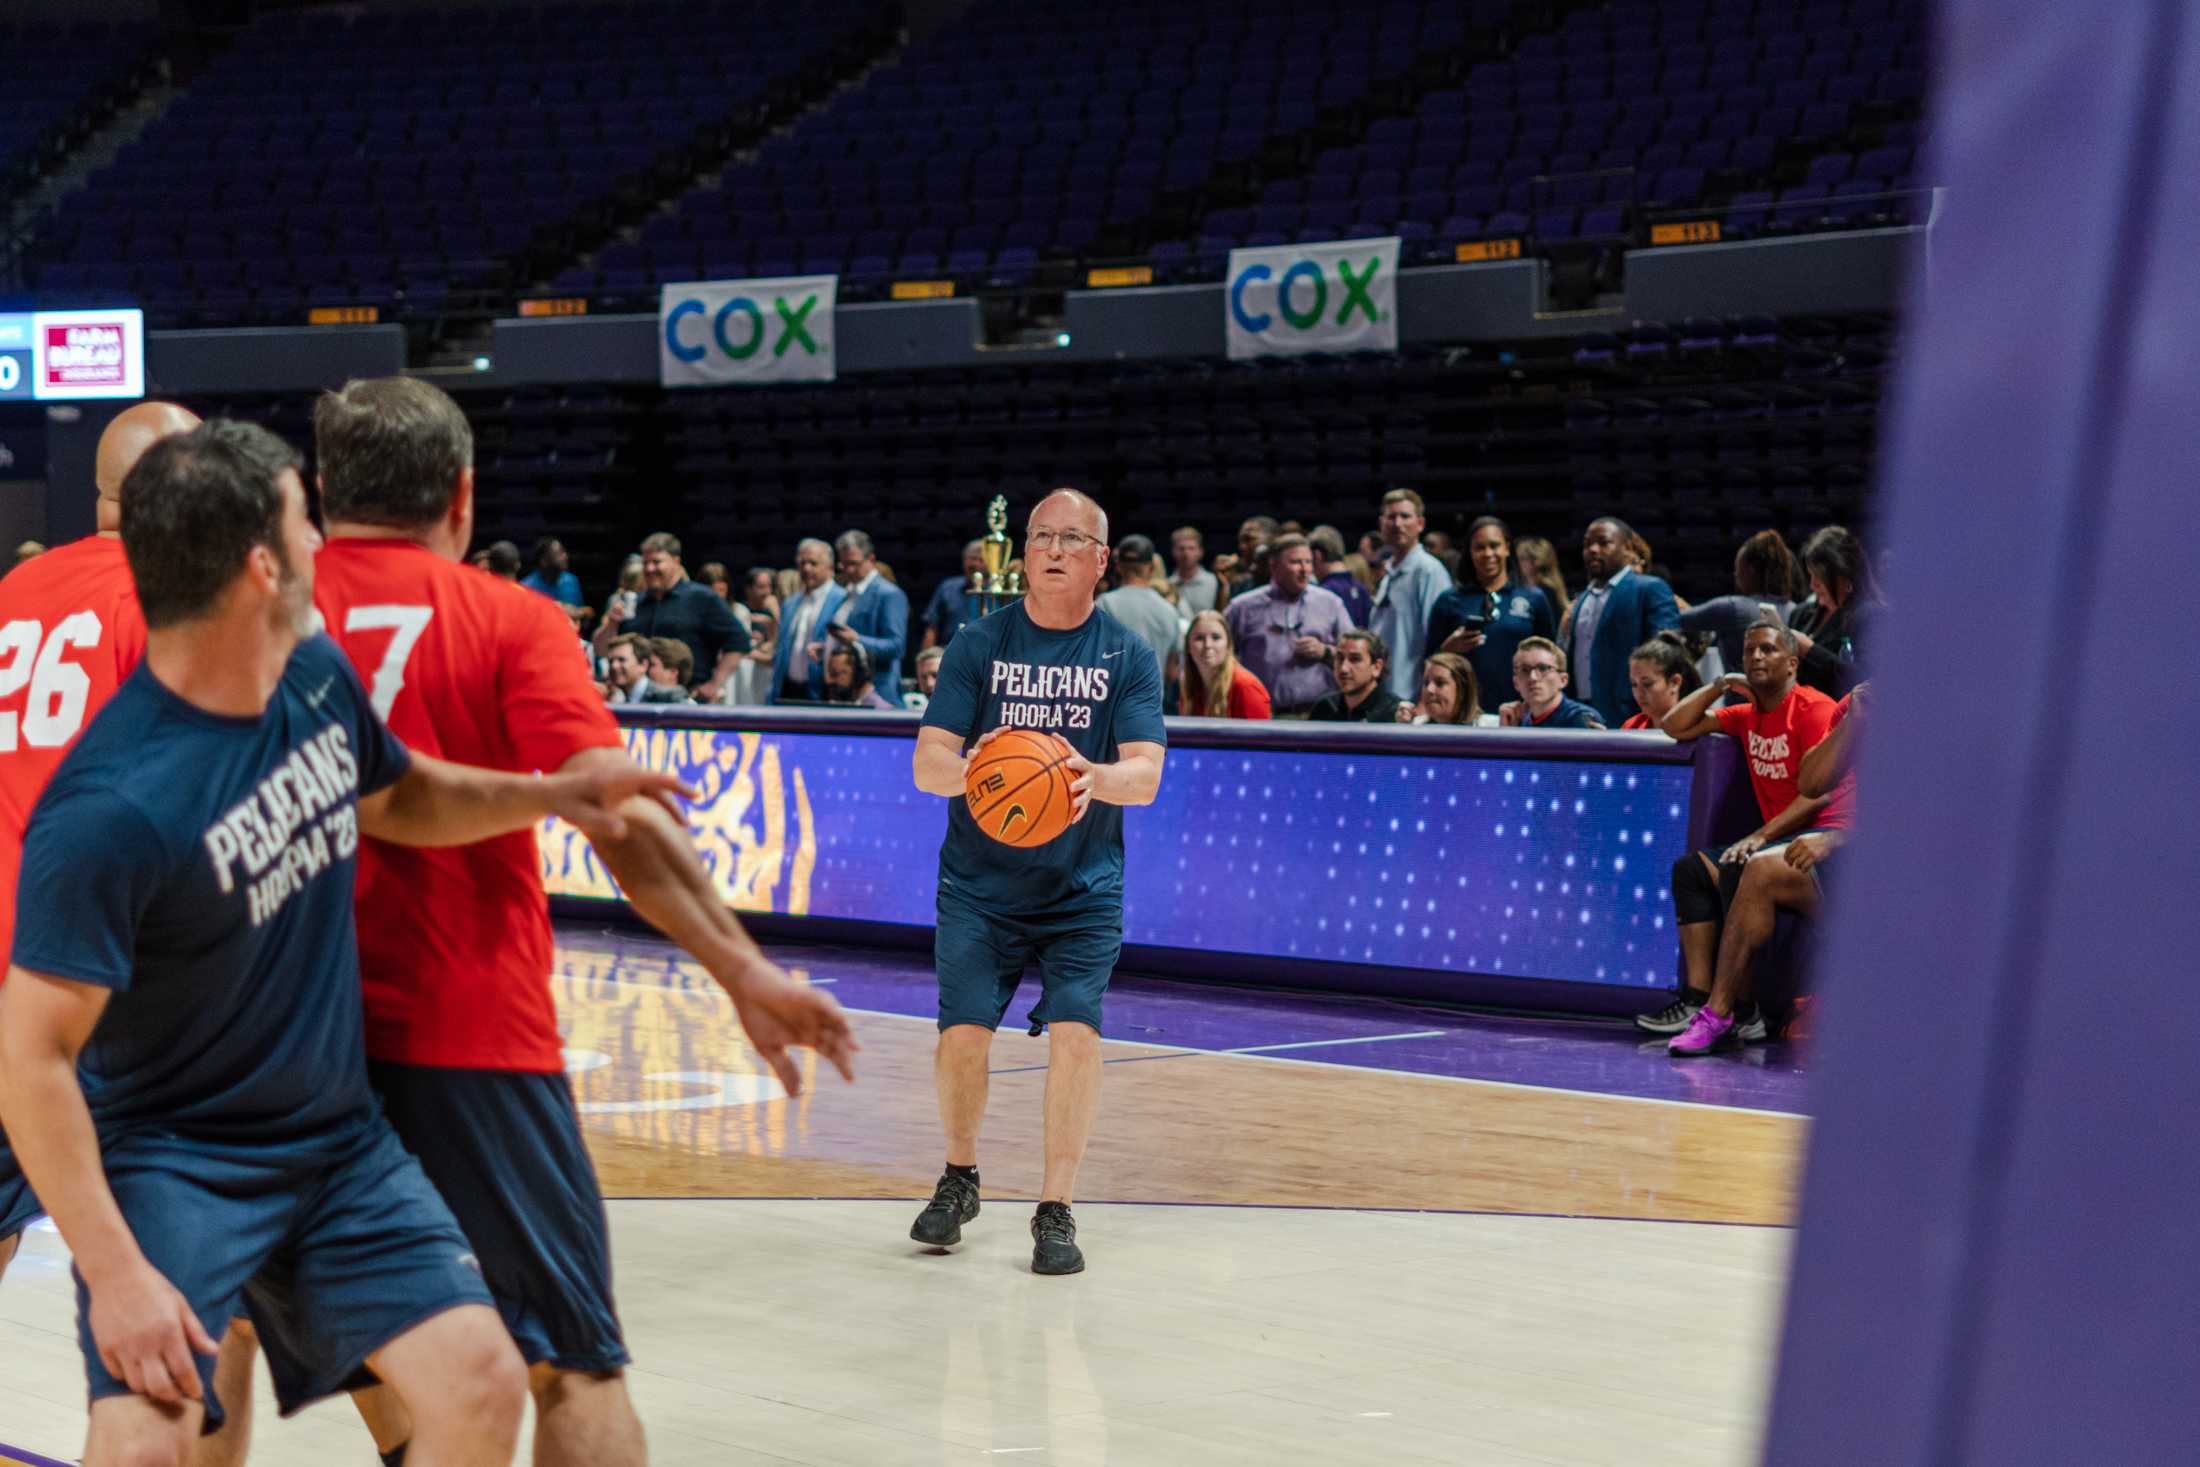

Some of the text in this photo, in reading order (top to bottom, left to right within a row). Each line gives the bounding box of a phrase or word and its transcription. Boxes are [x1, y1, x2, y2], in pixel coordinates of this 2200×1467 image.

[665, 293, 817, 363] COX
[1232, 256, 1380, 334] COX
[345, 605, 434, 724] 7
[991, 660, 1110, 702] PELICANS
[204, 723, 358, 894] PELICANS
